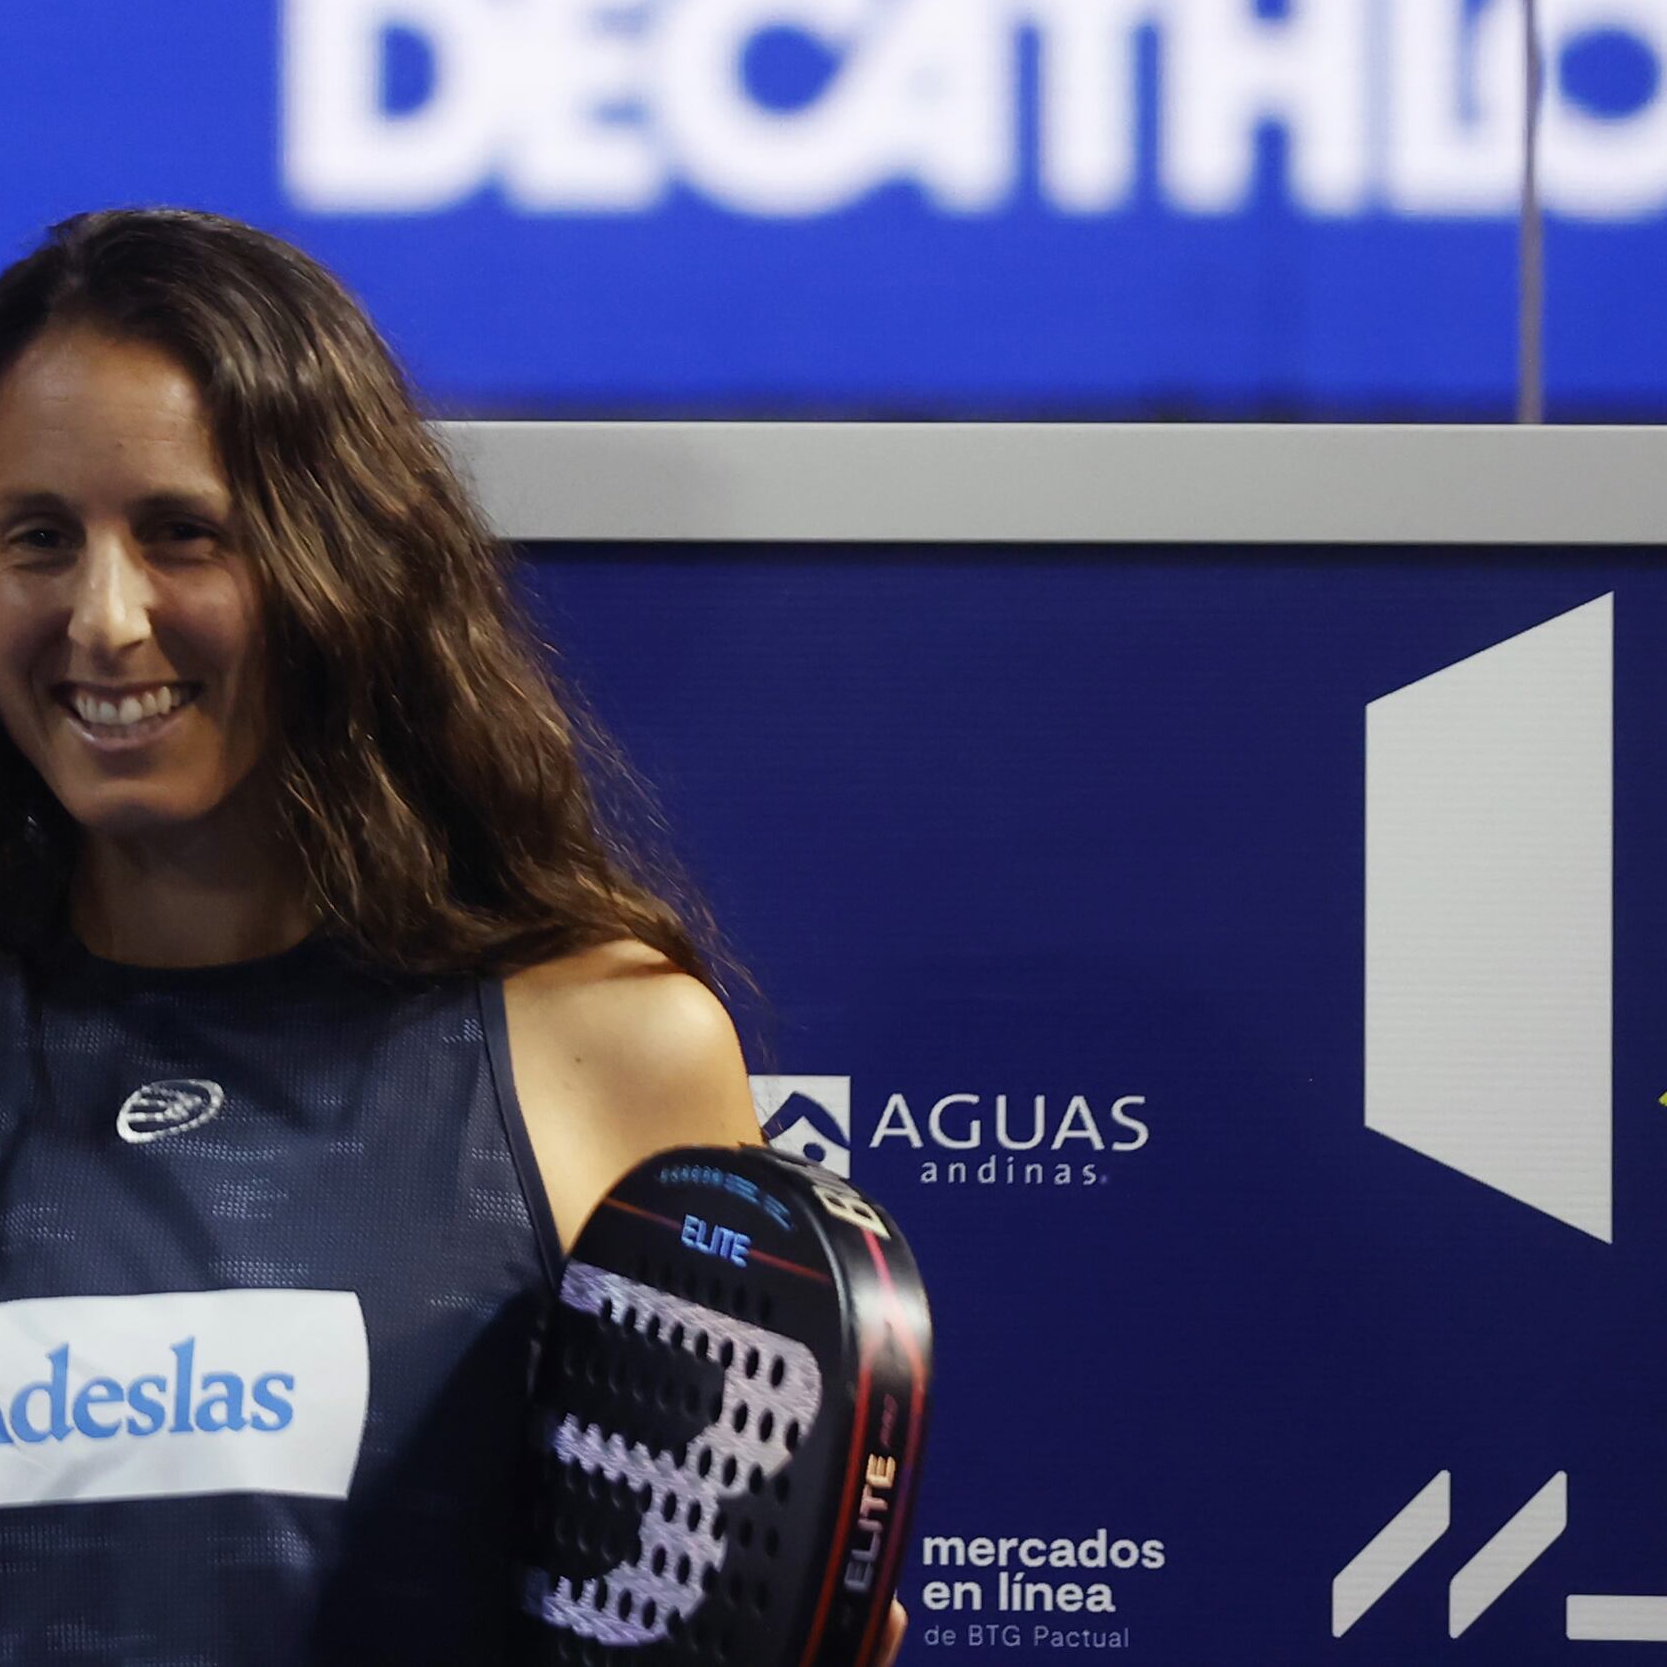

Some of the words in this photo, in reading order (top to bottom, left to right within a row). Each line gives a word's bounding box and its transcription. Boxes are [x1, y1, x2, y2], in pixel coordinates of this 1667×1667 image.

[869, 1093, 1149, 1151] AGUAS
[680, 1213, 753, 1268] ELITE
[843, 1453, 896, 1592] ELITE
[923, 1528, 1166, 1569] mercados
[922, 1581, 982, 1611] en
[998, 1571, 1116, 1613] línea
[924, 1625, 956, 1646] de
[968, 1624, 1021, 1647] BTG
[1034, 1625, 1130, 1648] Pactual
